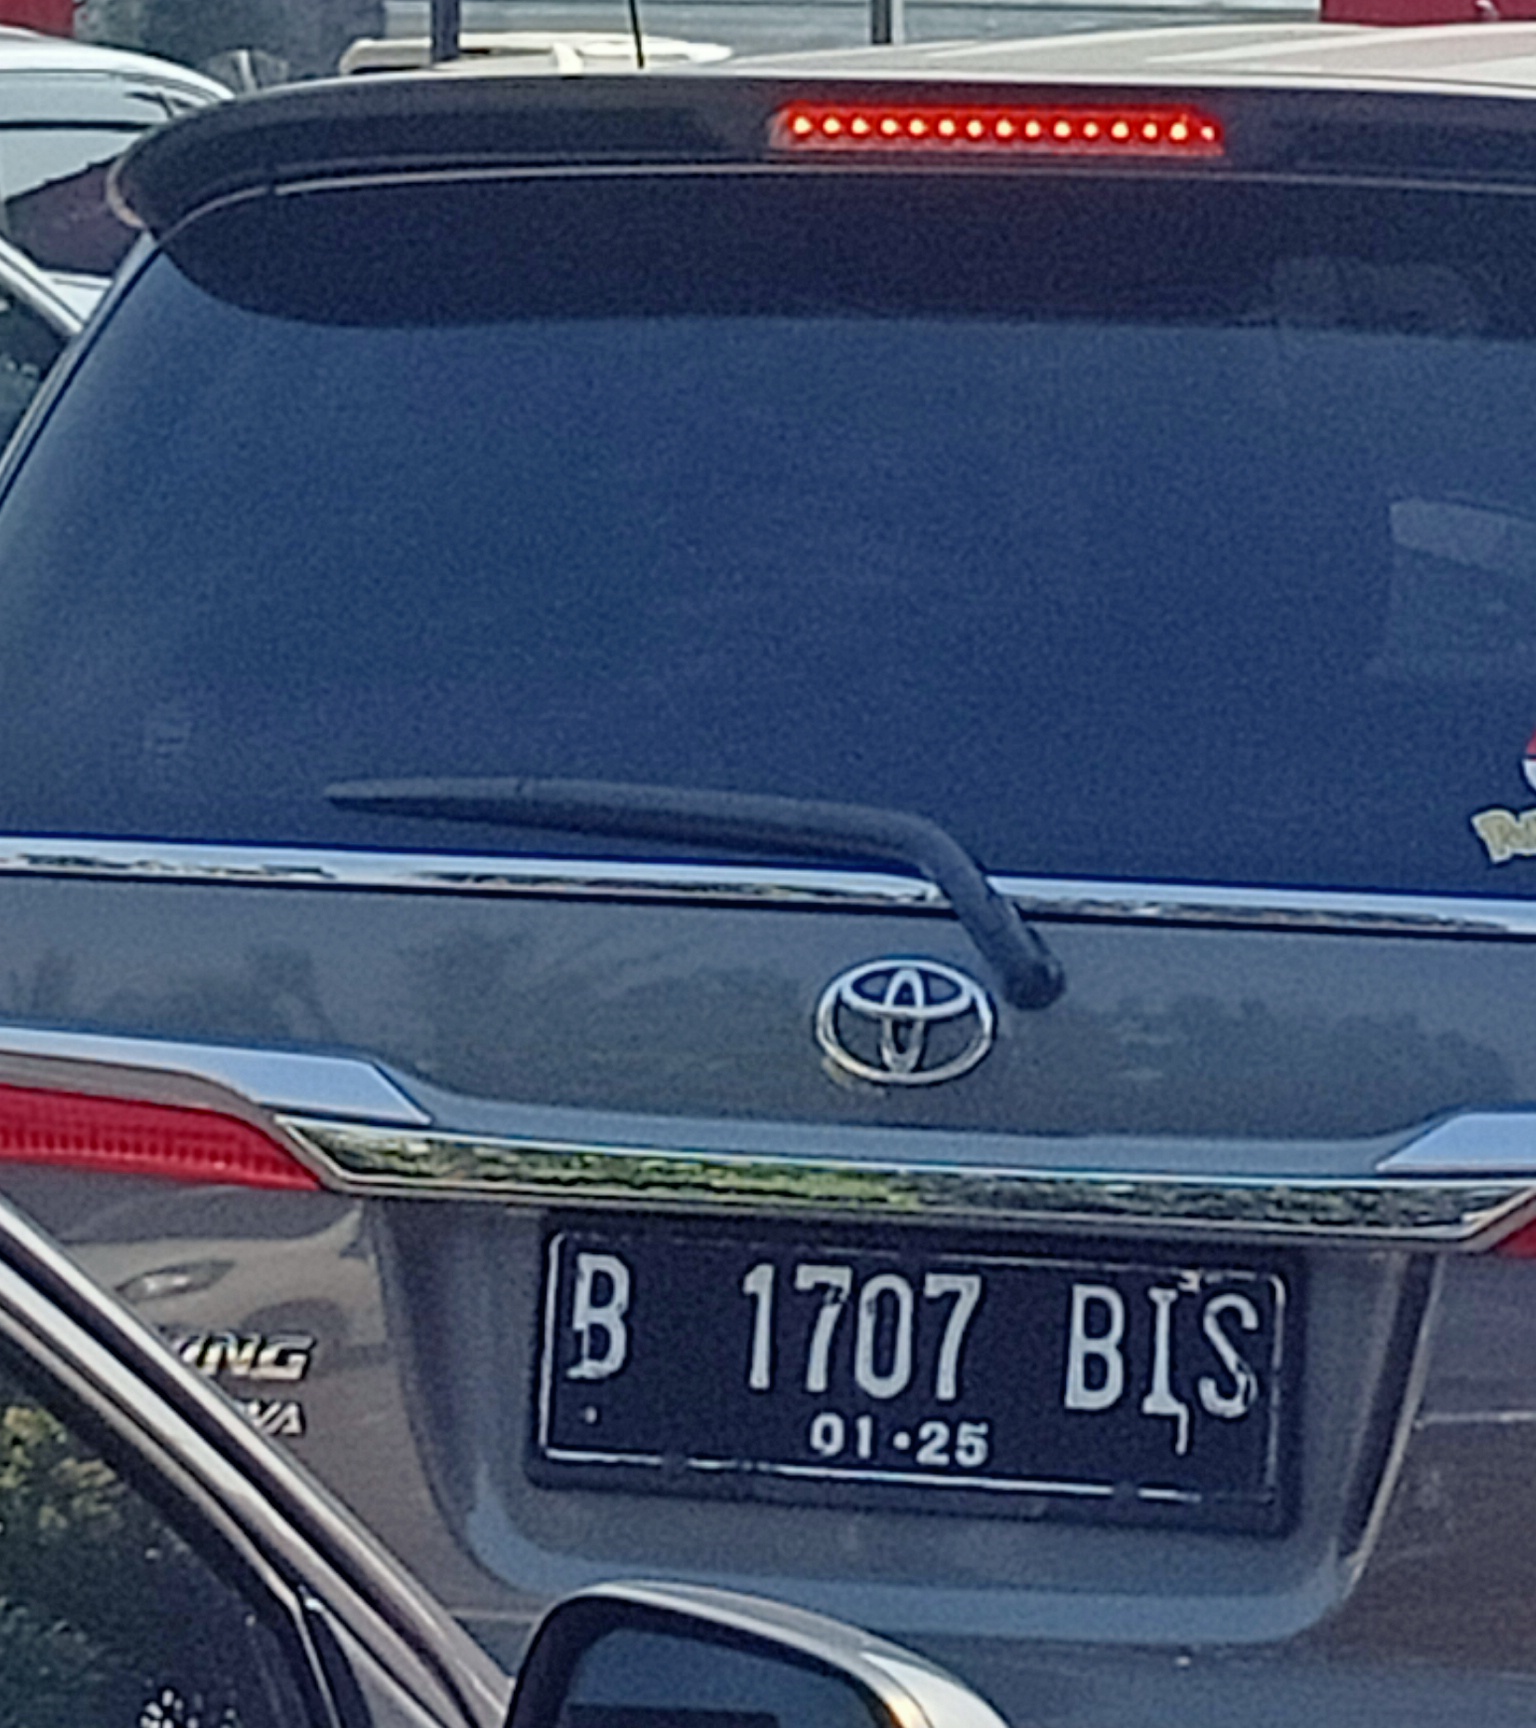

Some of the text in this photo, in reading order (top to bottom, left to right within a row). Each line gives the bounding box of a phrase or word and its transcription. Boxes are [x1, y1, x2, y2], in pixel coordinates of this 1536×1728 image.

[567, 1252, 1260, 1420] B 1707 BIS
